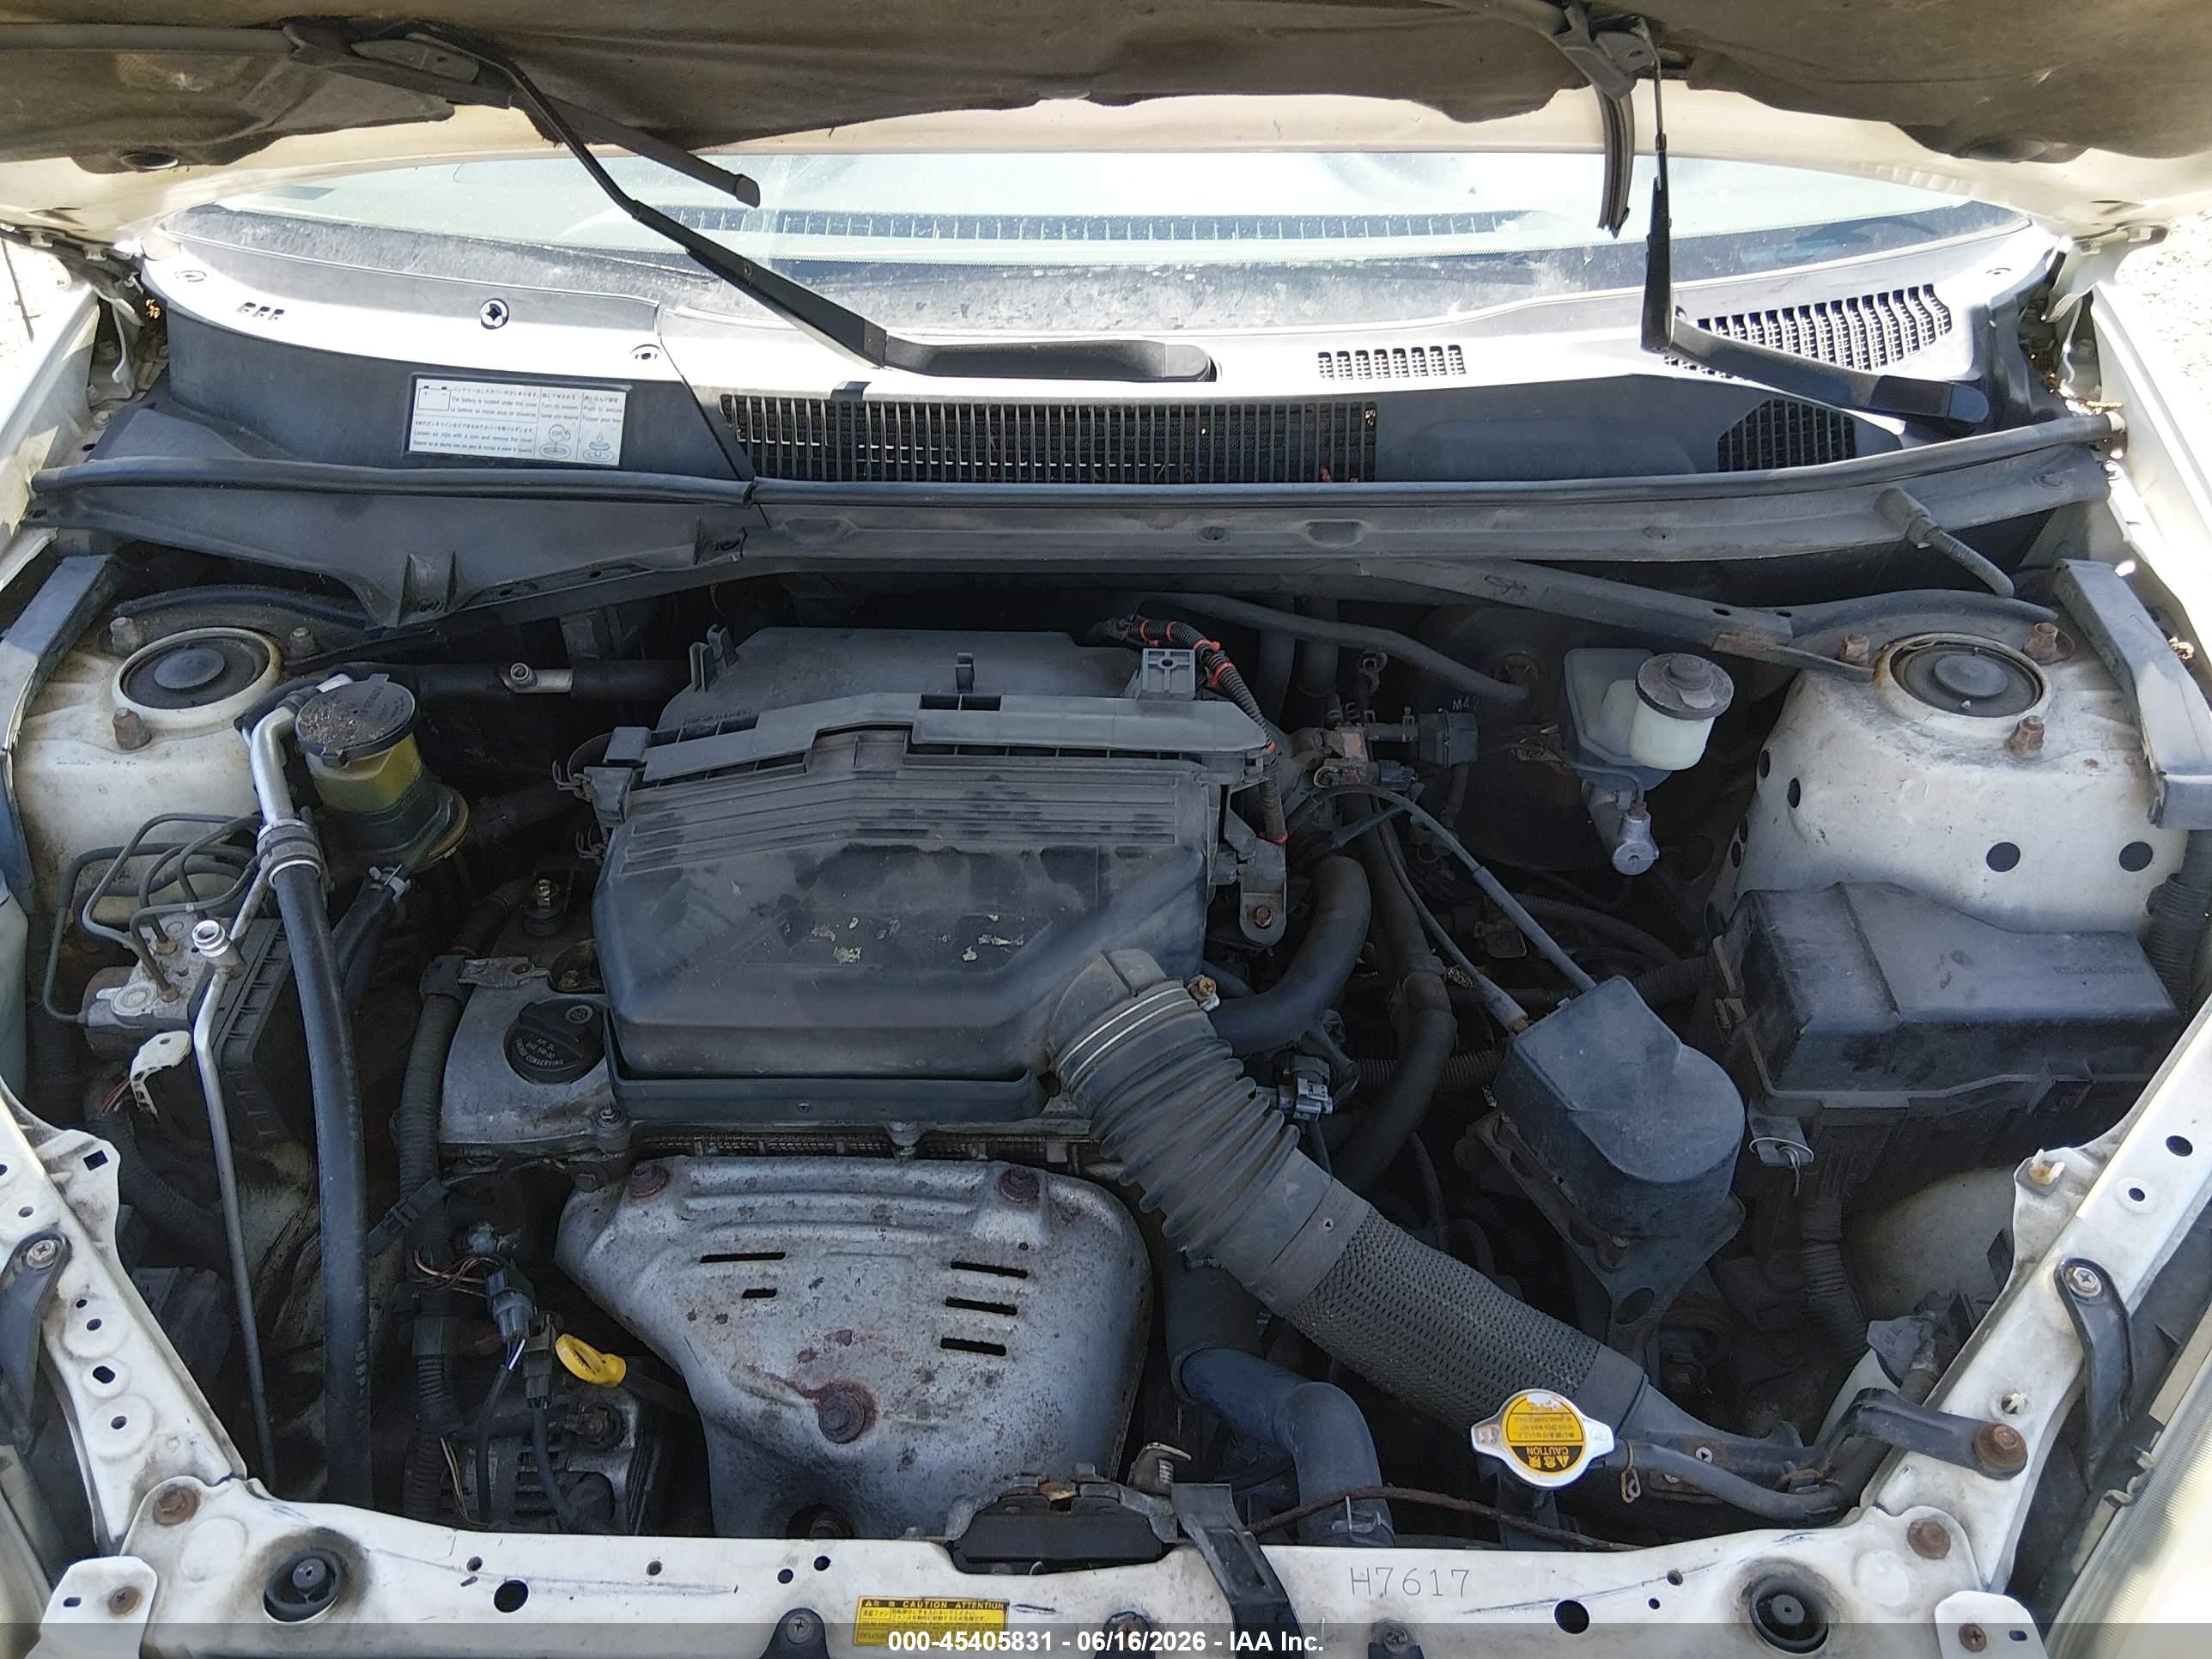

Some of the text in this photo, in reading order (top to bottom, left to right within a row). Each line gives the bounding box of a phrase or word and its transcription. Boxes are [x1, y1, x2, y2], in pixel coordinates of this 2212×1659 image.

[1526, 1447, 1569, 1456] CAUTION
[1350, 1566, 1470, 1598] H7617
[902, 1600, 948, 1609] CAUTION
[955, 1601, 1004, 1610] ATTENTION
